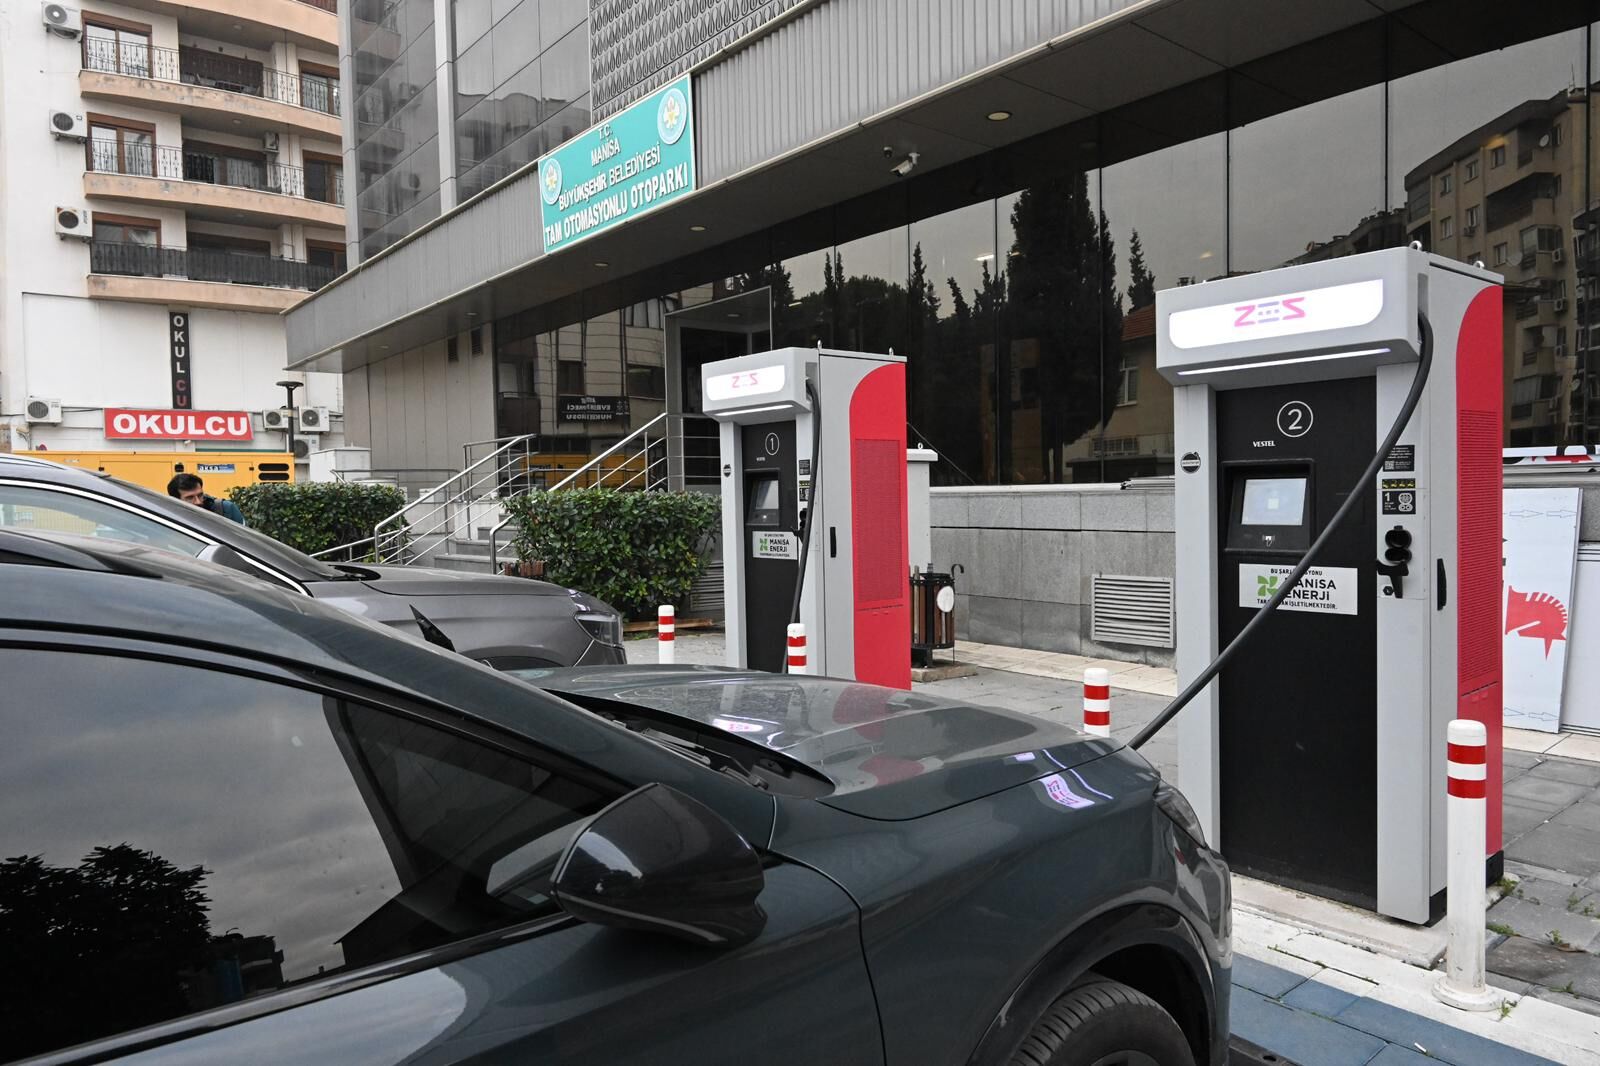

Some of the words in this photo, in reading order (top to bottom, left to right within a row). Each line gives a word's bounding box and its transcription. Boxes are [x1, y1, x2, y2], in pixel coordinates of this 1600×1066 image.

[591, 137, 621, 167] MANİSA
[559, 171, 607, 211] BÜYÜKŞEHİR
[610, 142, 661, 191] BELEDİYESİ
[545, 222, 562, 246] TAM
[563, 190, 628, 238] OTOMASYONLU
[630, 162, 688, 209] OTOPARKI
[173, 315, 187, 406] OKULCU
[113, 414, 248, 435] OKULCU
[1288, 409, 1303, 430] 2
[1252, 440, 1276, 448] VESTEL
